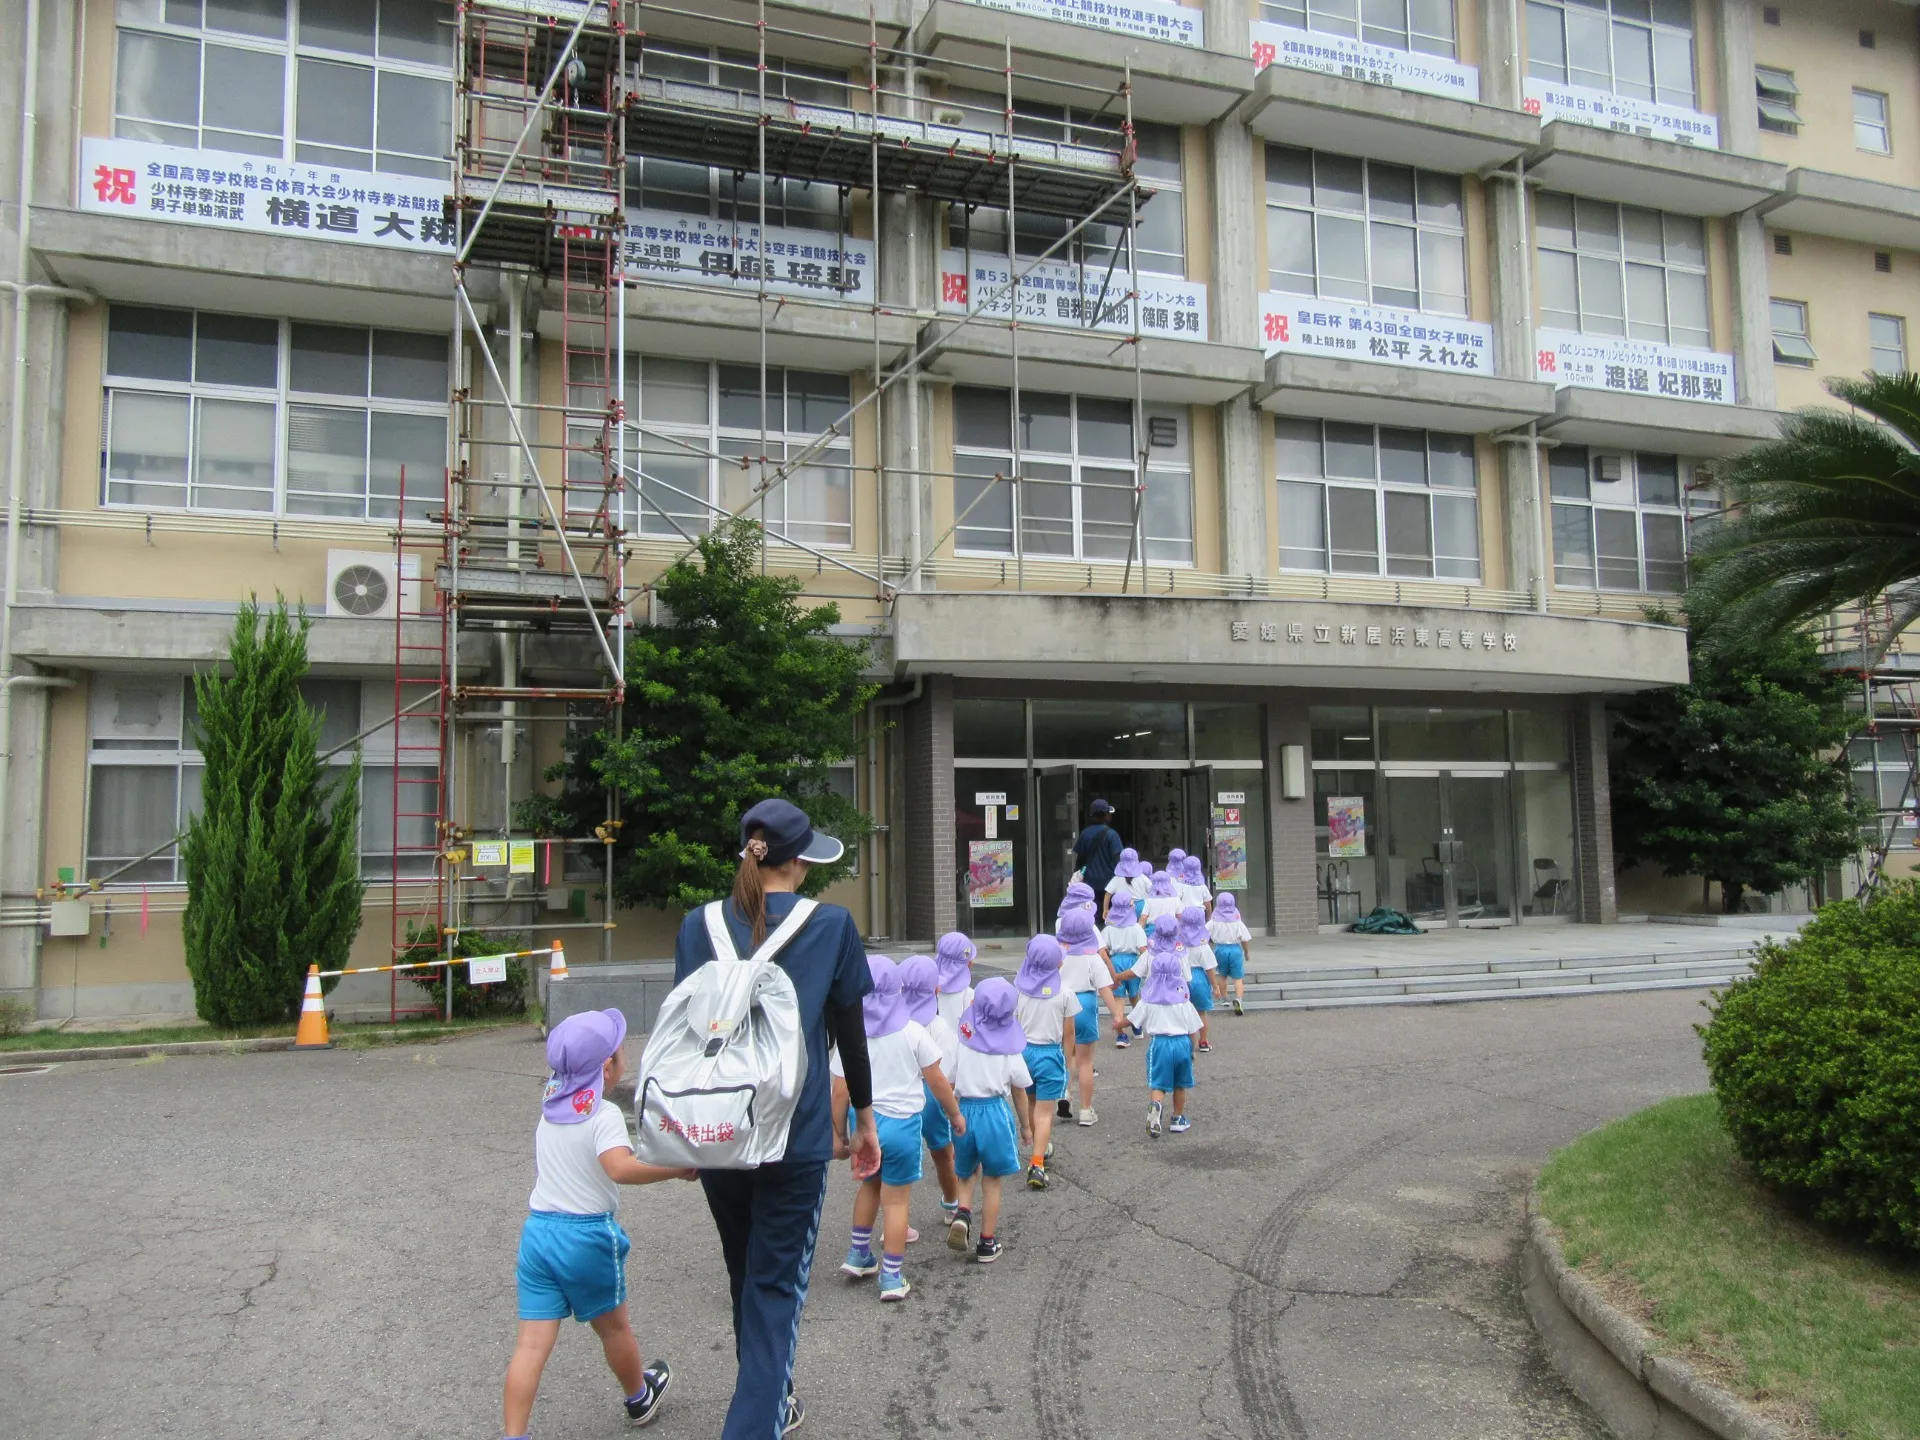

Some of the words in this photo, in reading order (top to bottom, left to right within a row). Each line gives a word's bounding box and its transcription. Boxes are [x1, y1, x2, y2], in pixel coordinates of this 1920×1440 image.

[1252, 40, 1276, 68] 祝
[1523, 97, 1541, 115] 祝
[93, 165, 137, 205] 祝
[242, 161, 341, 183] 令和7年度
[147, 162, 443, 213] 全国高等学校総合体育大会少林寺拳法競技
[151, 182, 245, 206] 少林寺拳法部
[150, 197, 244, 221] 男子単独演武
[622, 241, 681, 260] 手道部
[942, 271, 968, 305] 祝
[975, 268, 1196, 307] 第53全国高等学校選抜バドントン大会
[1263, 312, 1290, 342] 祝
[1297, 310, 1342, 328] 皇后杯
[1348, 317, 1484, 348] 第43回全国女子駅伝
[1301, 333, 1357, 350] 陸上競技部
[1537, 350, 1556, 372] 祝
[1231, 621, 1517, 652] 愛媛県立新居浜東高等学校
